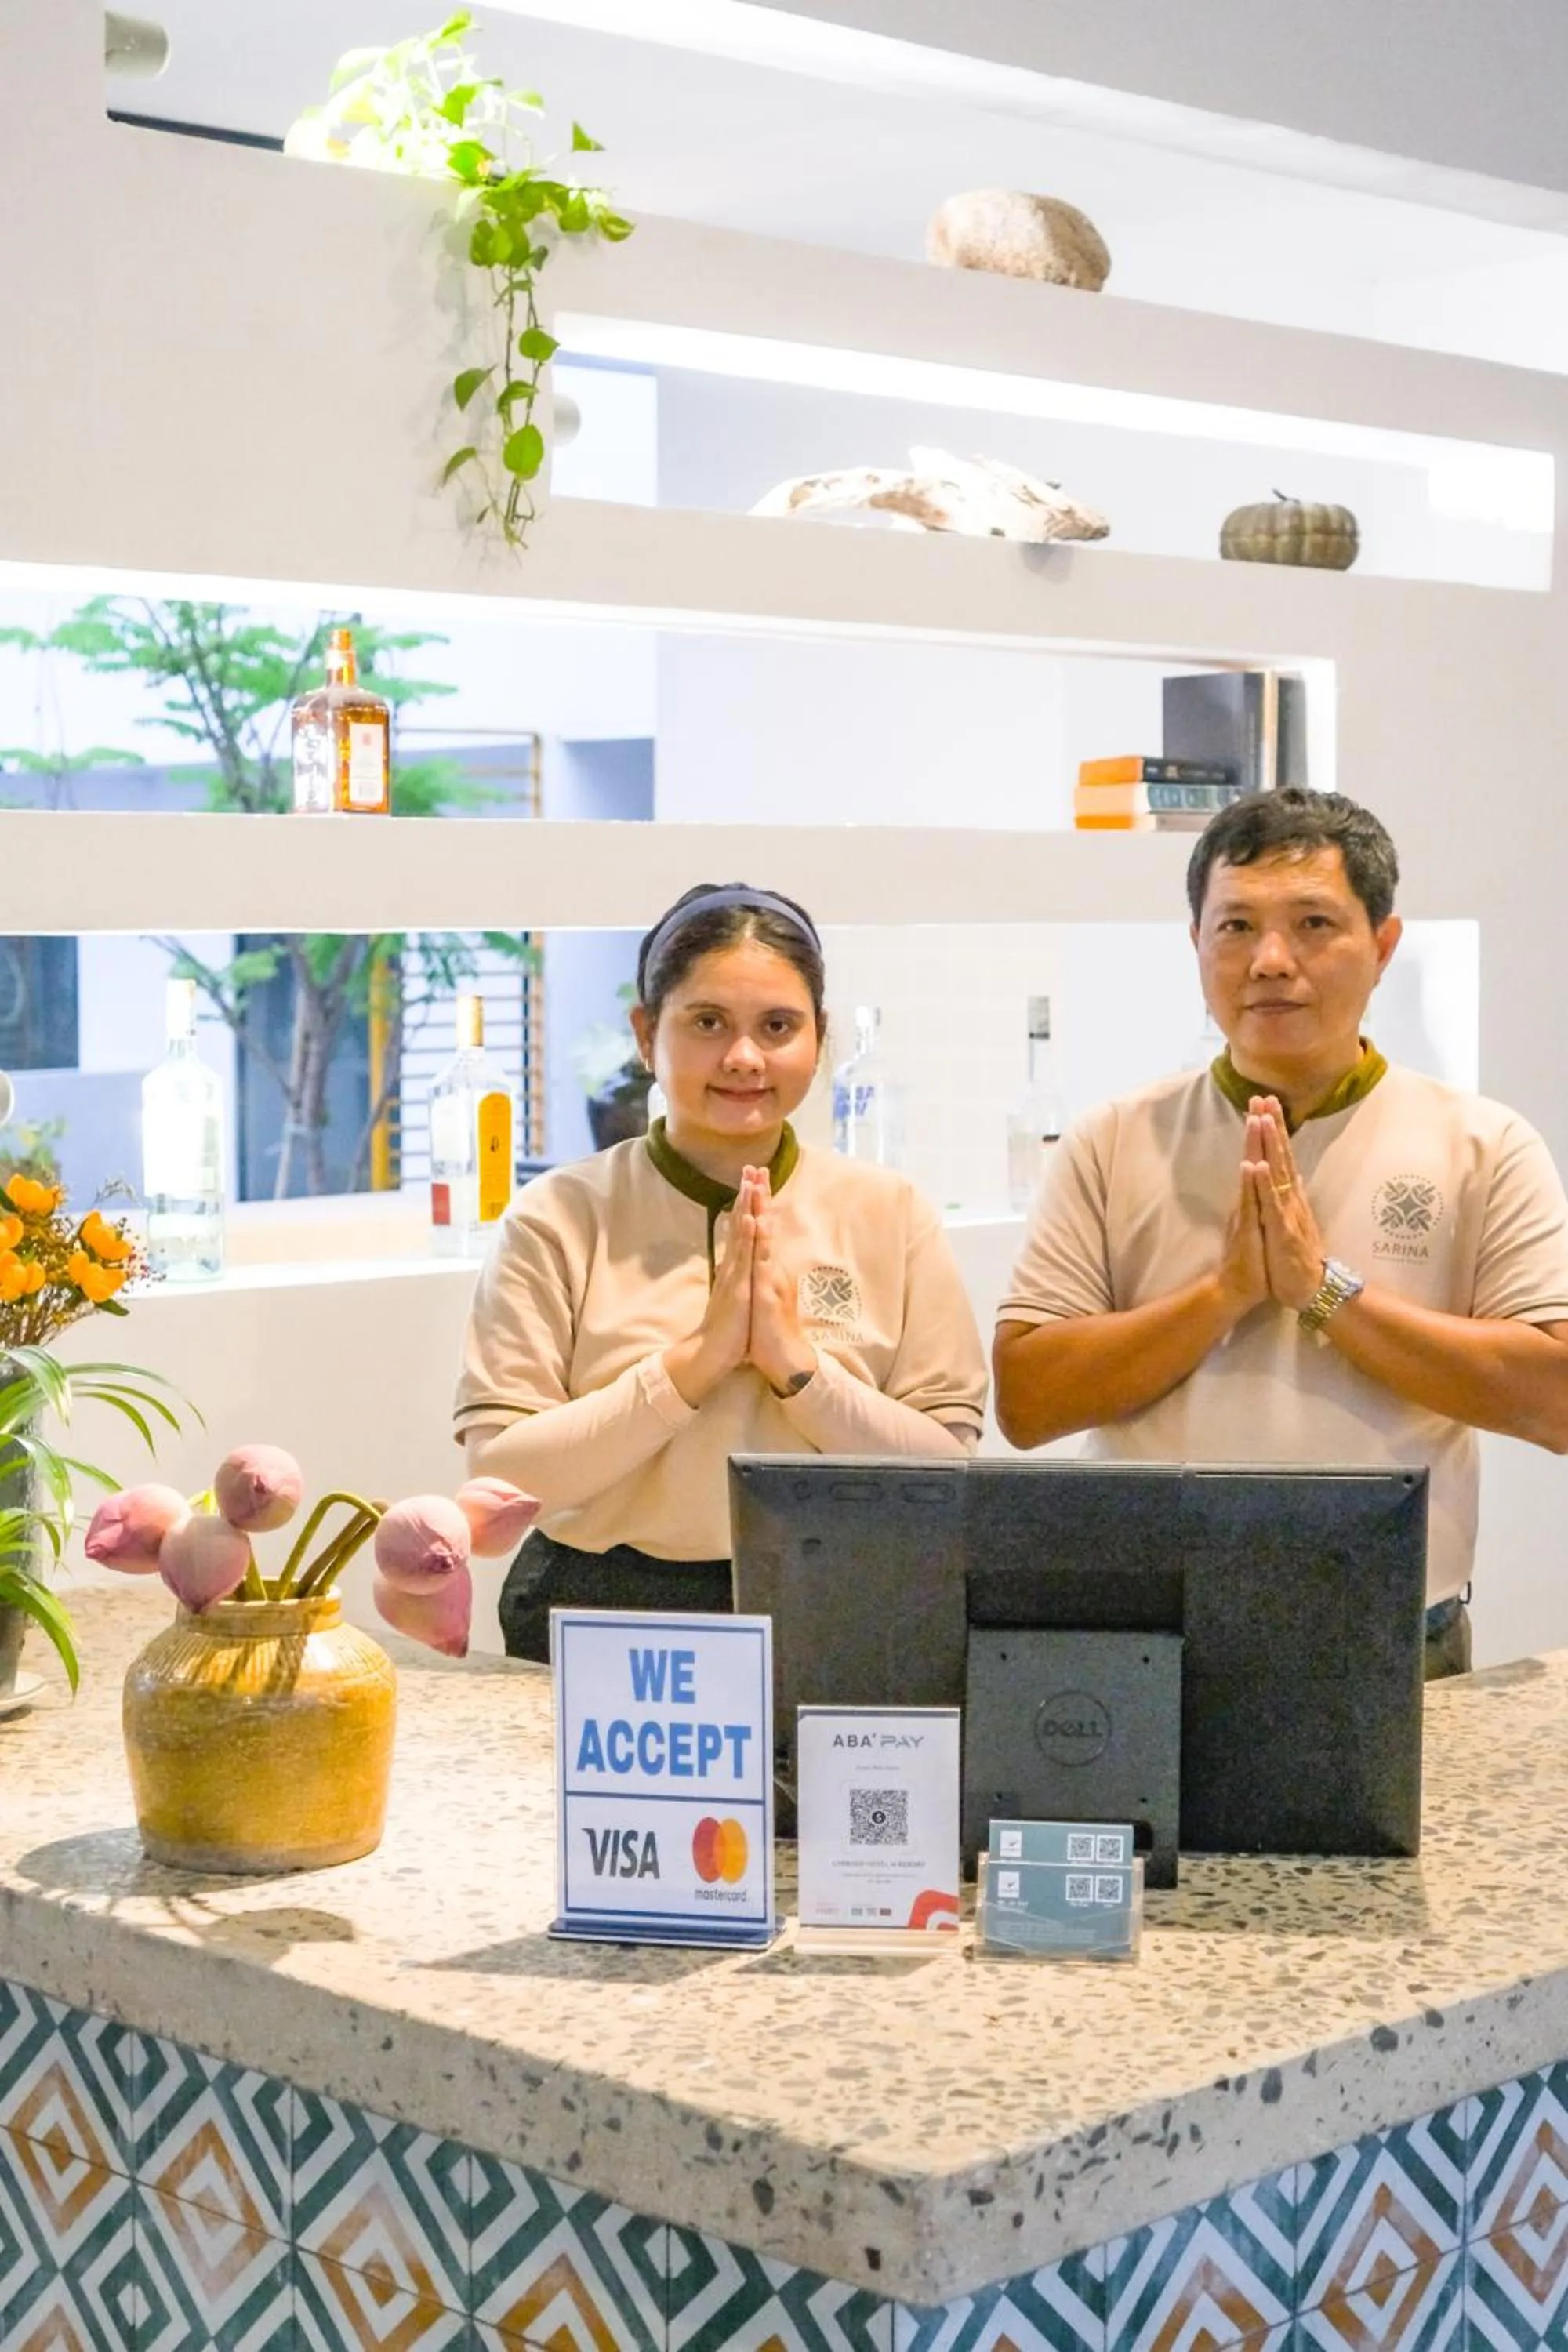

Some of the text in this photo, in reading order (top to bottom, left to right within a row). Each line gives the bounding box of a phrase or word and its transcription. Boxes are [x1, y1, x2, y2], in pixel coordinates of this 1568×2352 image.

[1372, 1241, 1429, 1258] SARINA
[629, 1648, 696, 1704] WE
[1044, 1719, 1103, 1737] DELL
[576, 1719, 752, 1779] ACCEPT
[880, 1735, 924, 1749] PAY
[581, 1828, 660, 1880] VISA
[695, 1889, 747, 1903] mastercard
